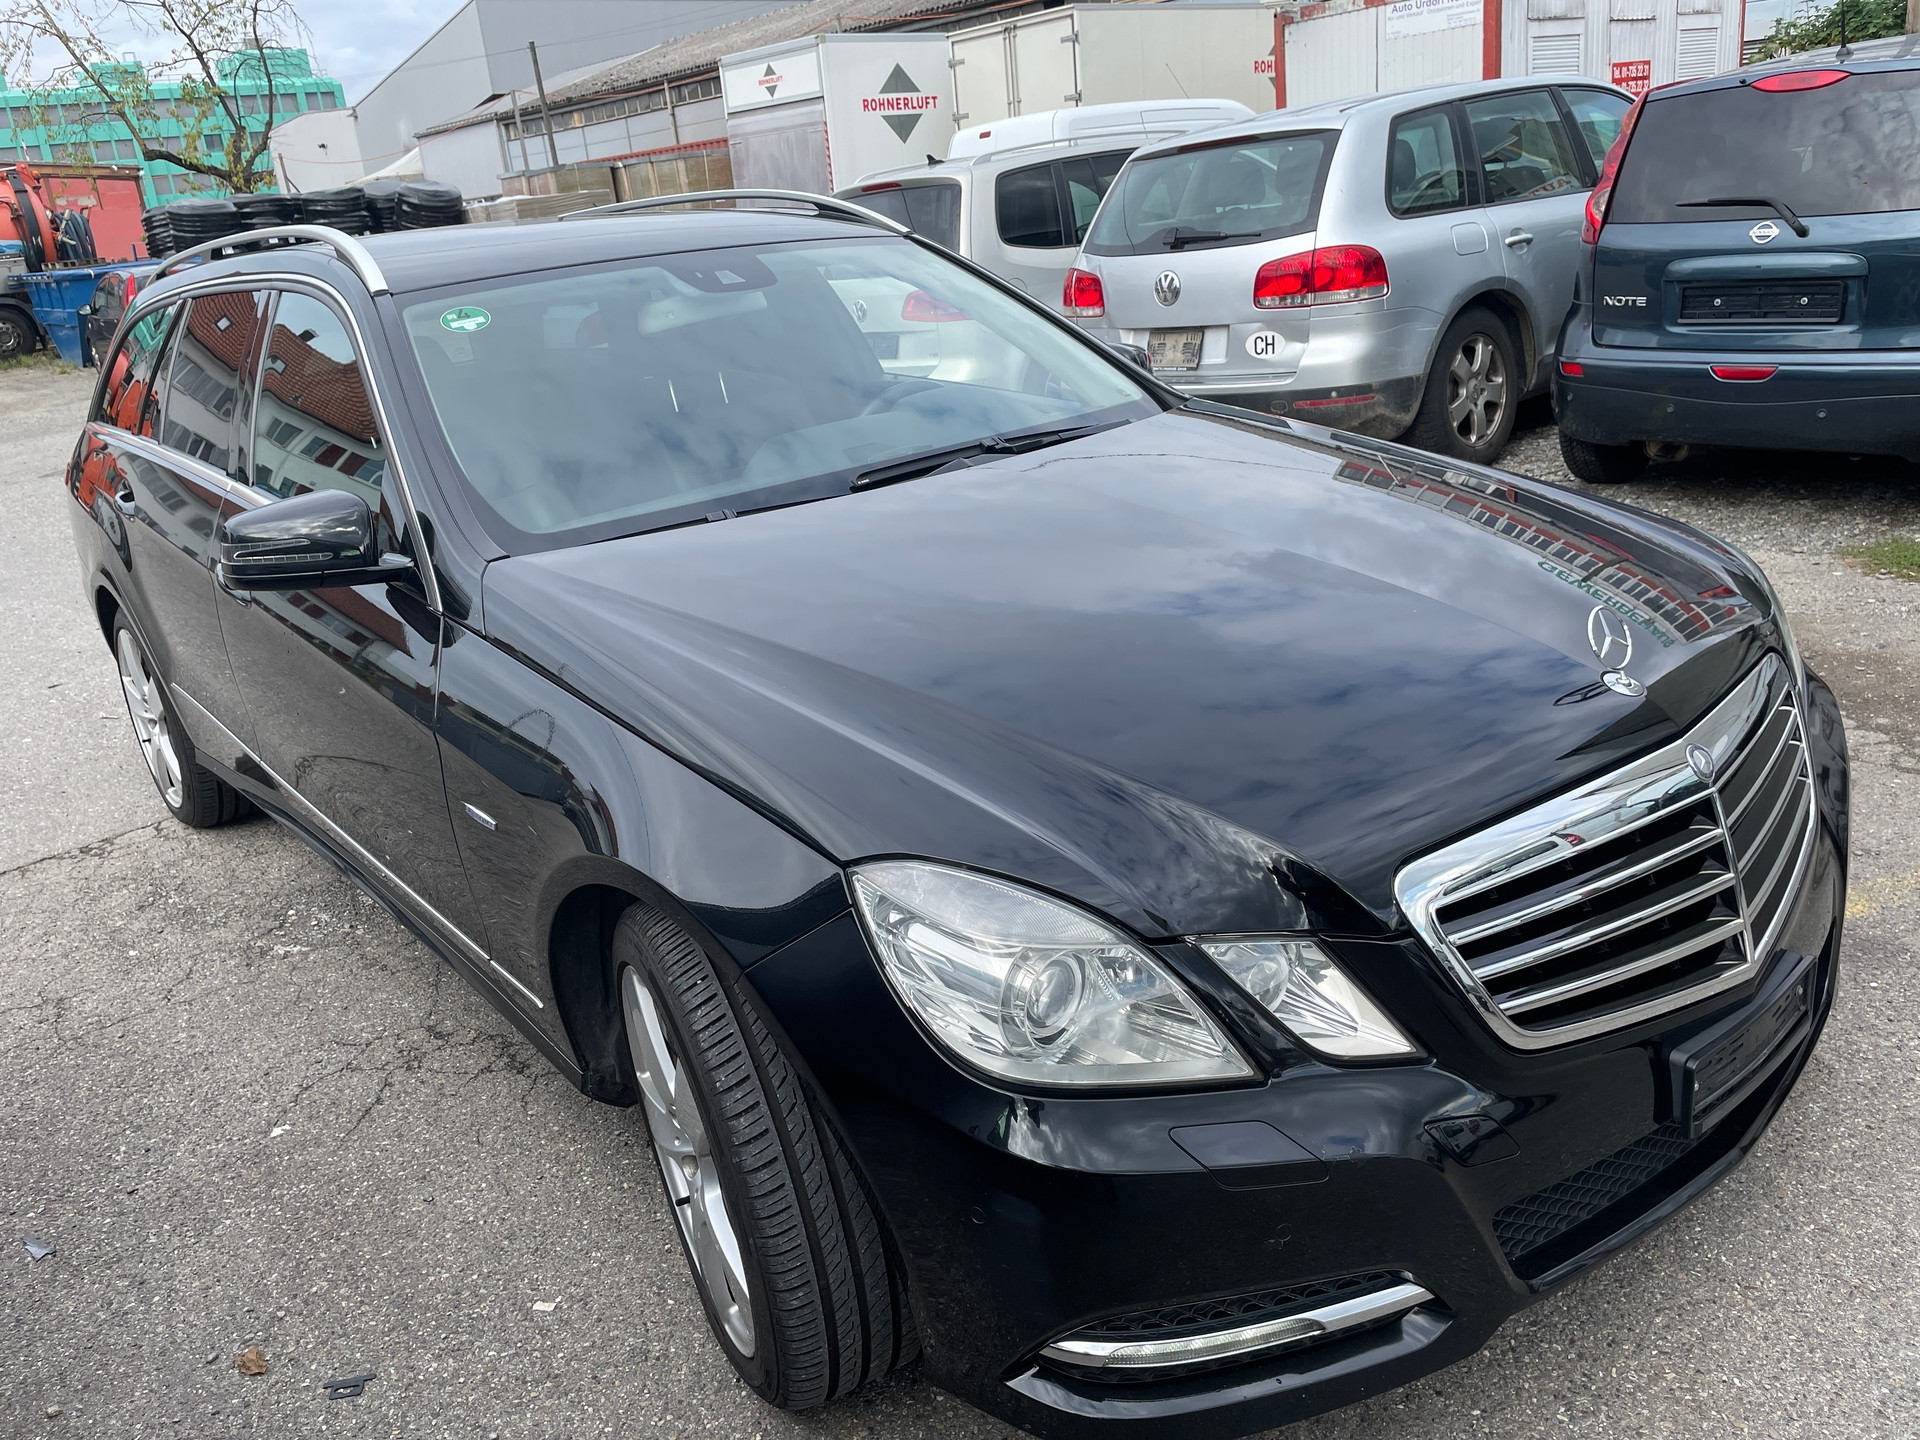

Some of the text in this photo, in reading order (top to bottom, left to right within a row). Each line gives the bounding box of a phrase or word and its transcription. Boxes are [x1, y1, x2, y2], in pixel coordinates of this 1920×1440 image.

[1391, 3, 1413, 14] Auto
[1254, 60, 1275, 73] ROH
[862, 95, 938, 112] ROHNERLUFT
[1603, 296, 1647, 306] NOTE
[1254, 335, 1275, 356] CH
